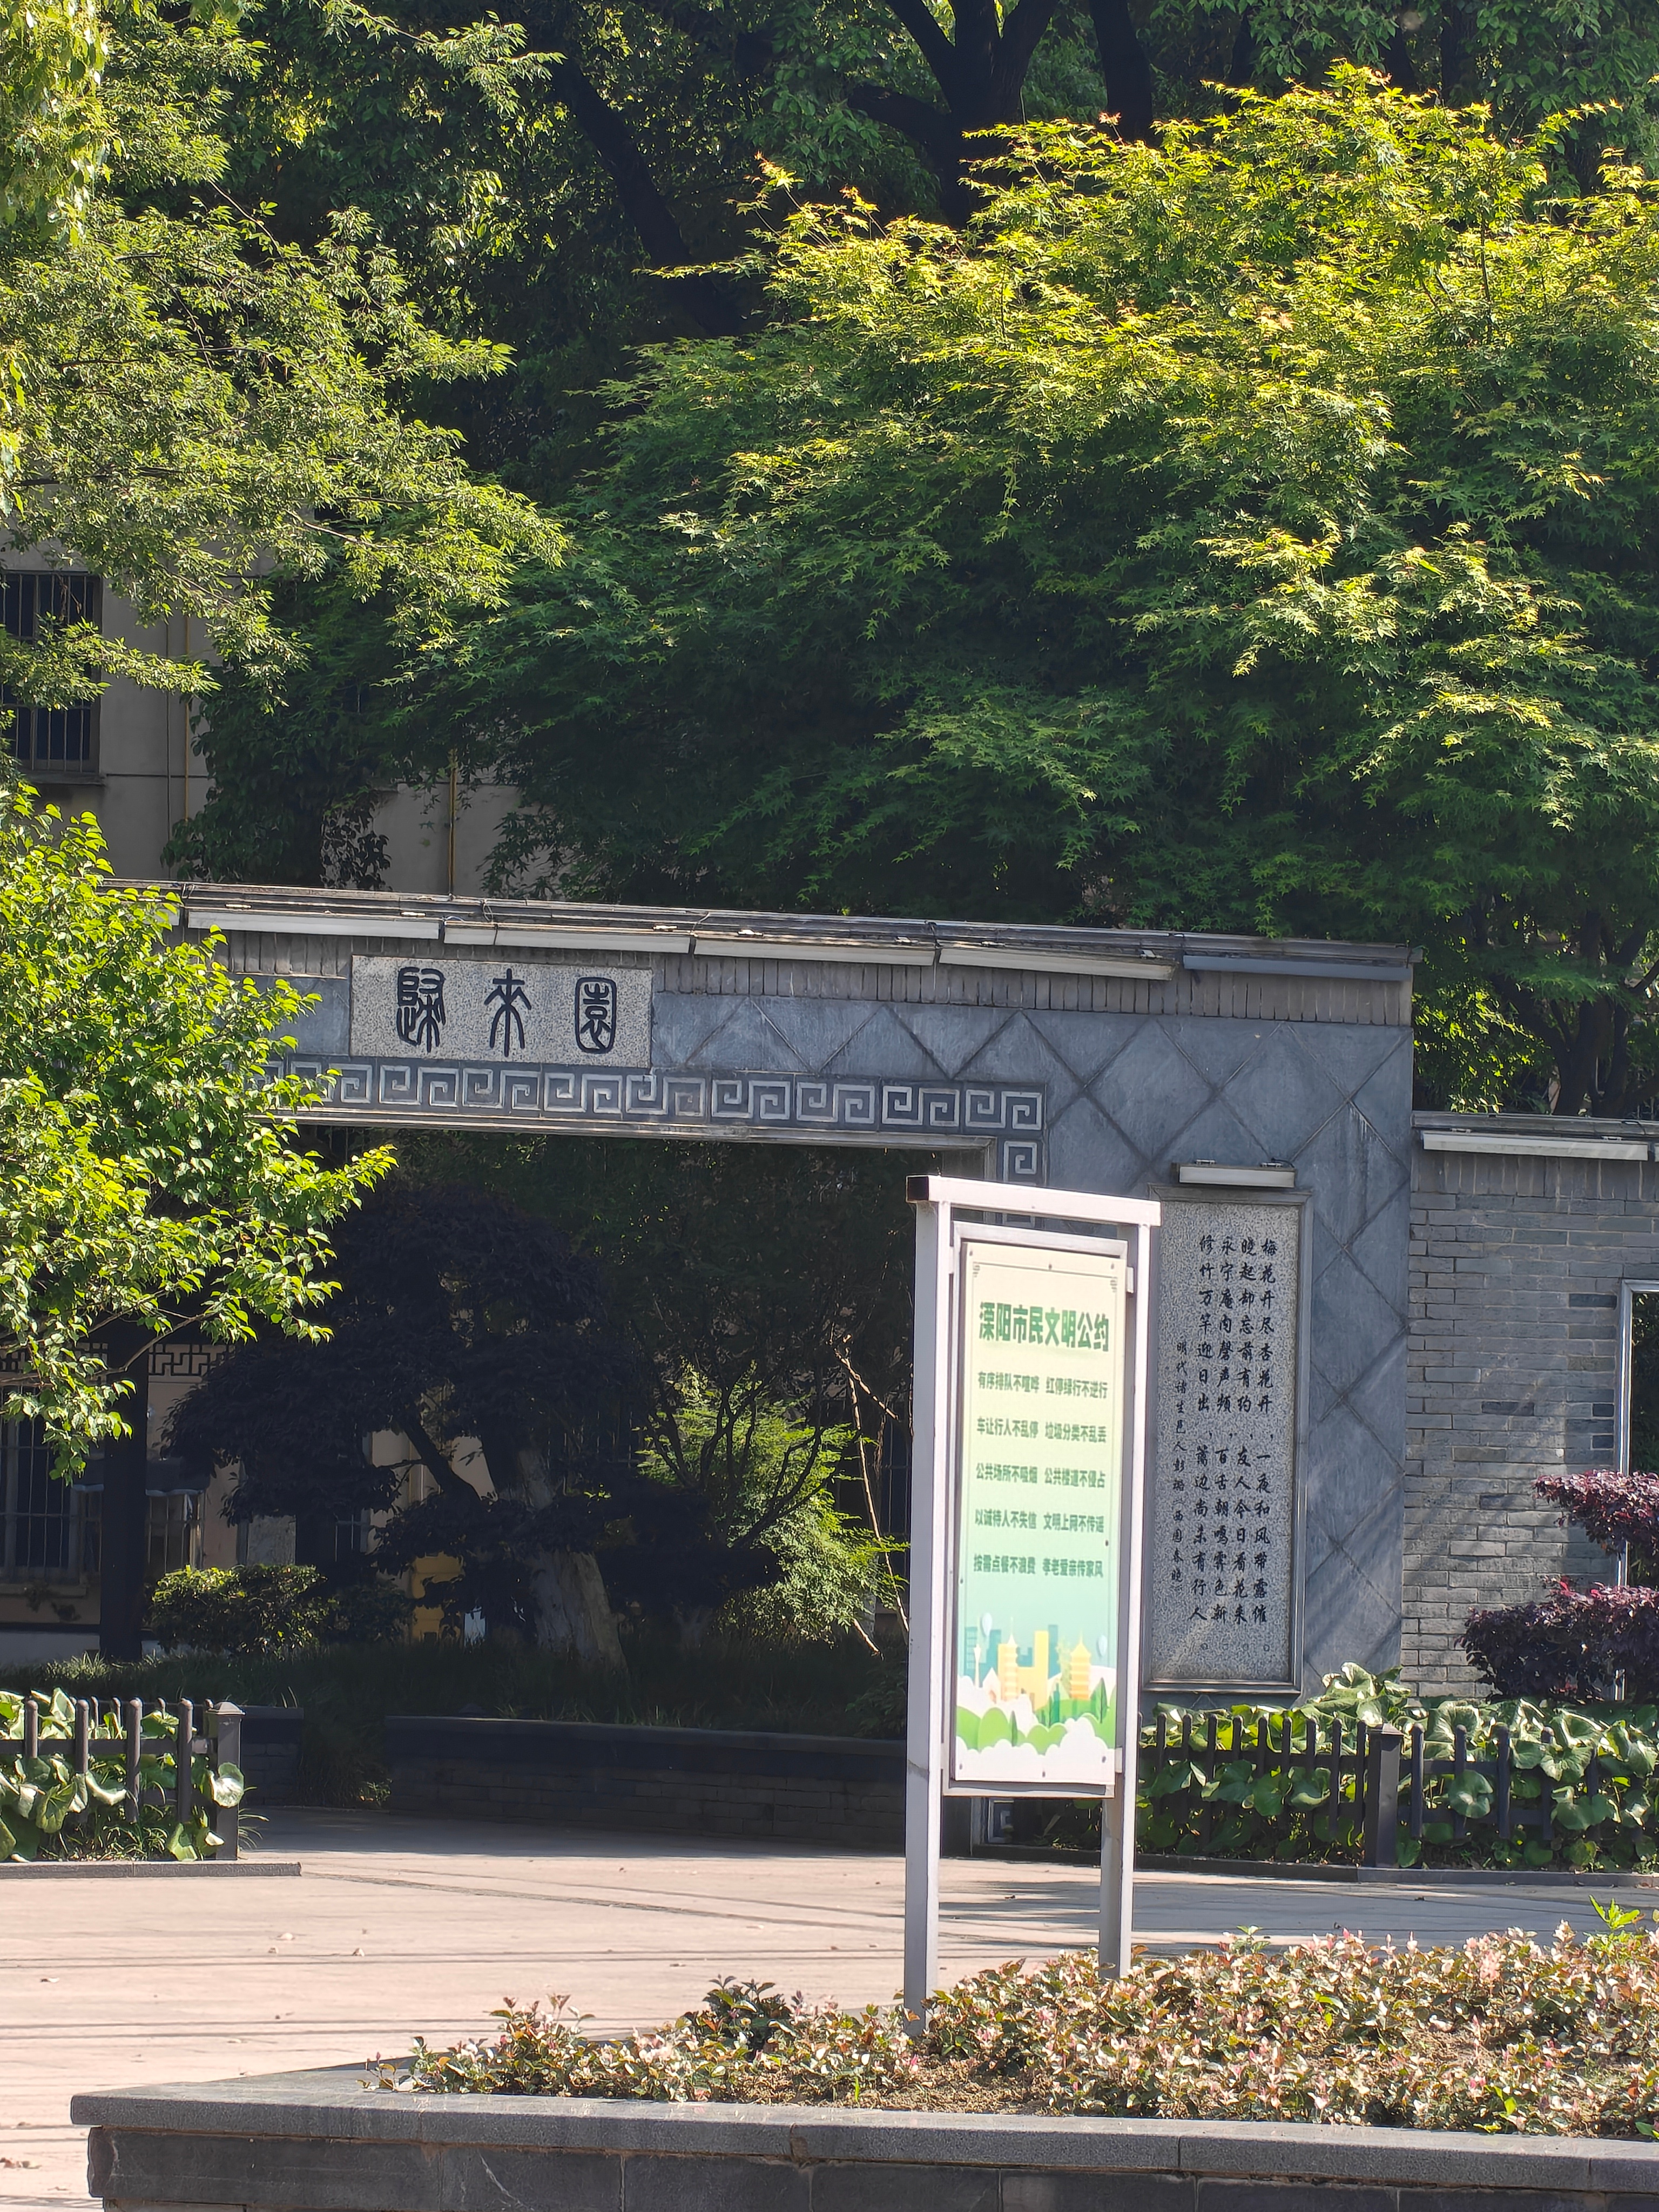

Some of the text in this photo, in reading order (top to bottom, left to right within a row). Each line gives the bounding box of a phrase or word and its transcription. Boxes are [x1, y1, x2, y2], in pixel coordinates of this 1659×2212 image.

[979, 1301, 1109, 1352] 溧阳市民文明公约
[977, 1371, 1108, 1399] 有序排队不喧哗 红停绿行不逆行
[976, 1416, 1107, 1443] 车让行人不乱停 垃圾分类不乱丢
[975, 1462, 1106, 1488] 公共场所不吸烟 公共楼道不侵占
[975, 1508, 1104, 1533] 以诚待人不失信 文明上网不传谣
[973, 1553, 1103, 1578] 按需点餐不浪费 孝老爱亲传家风
